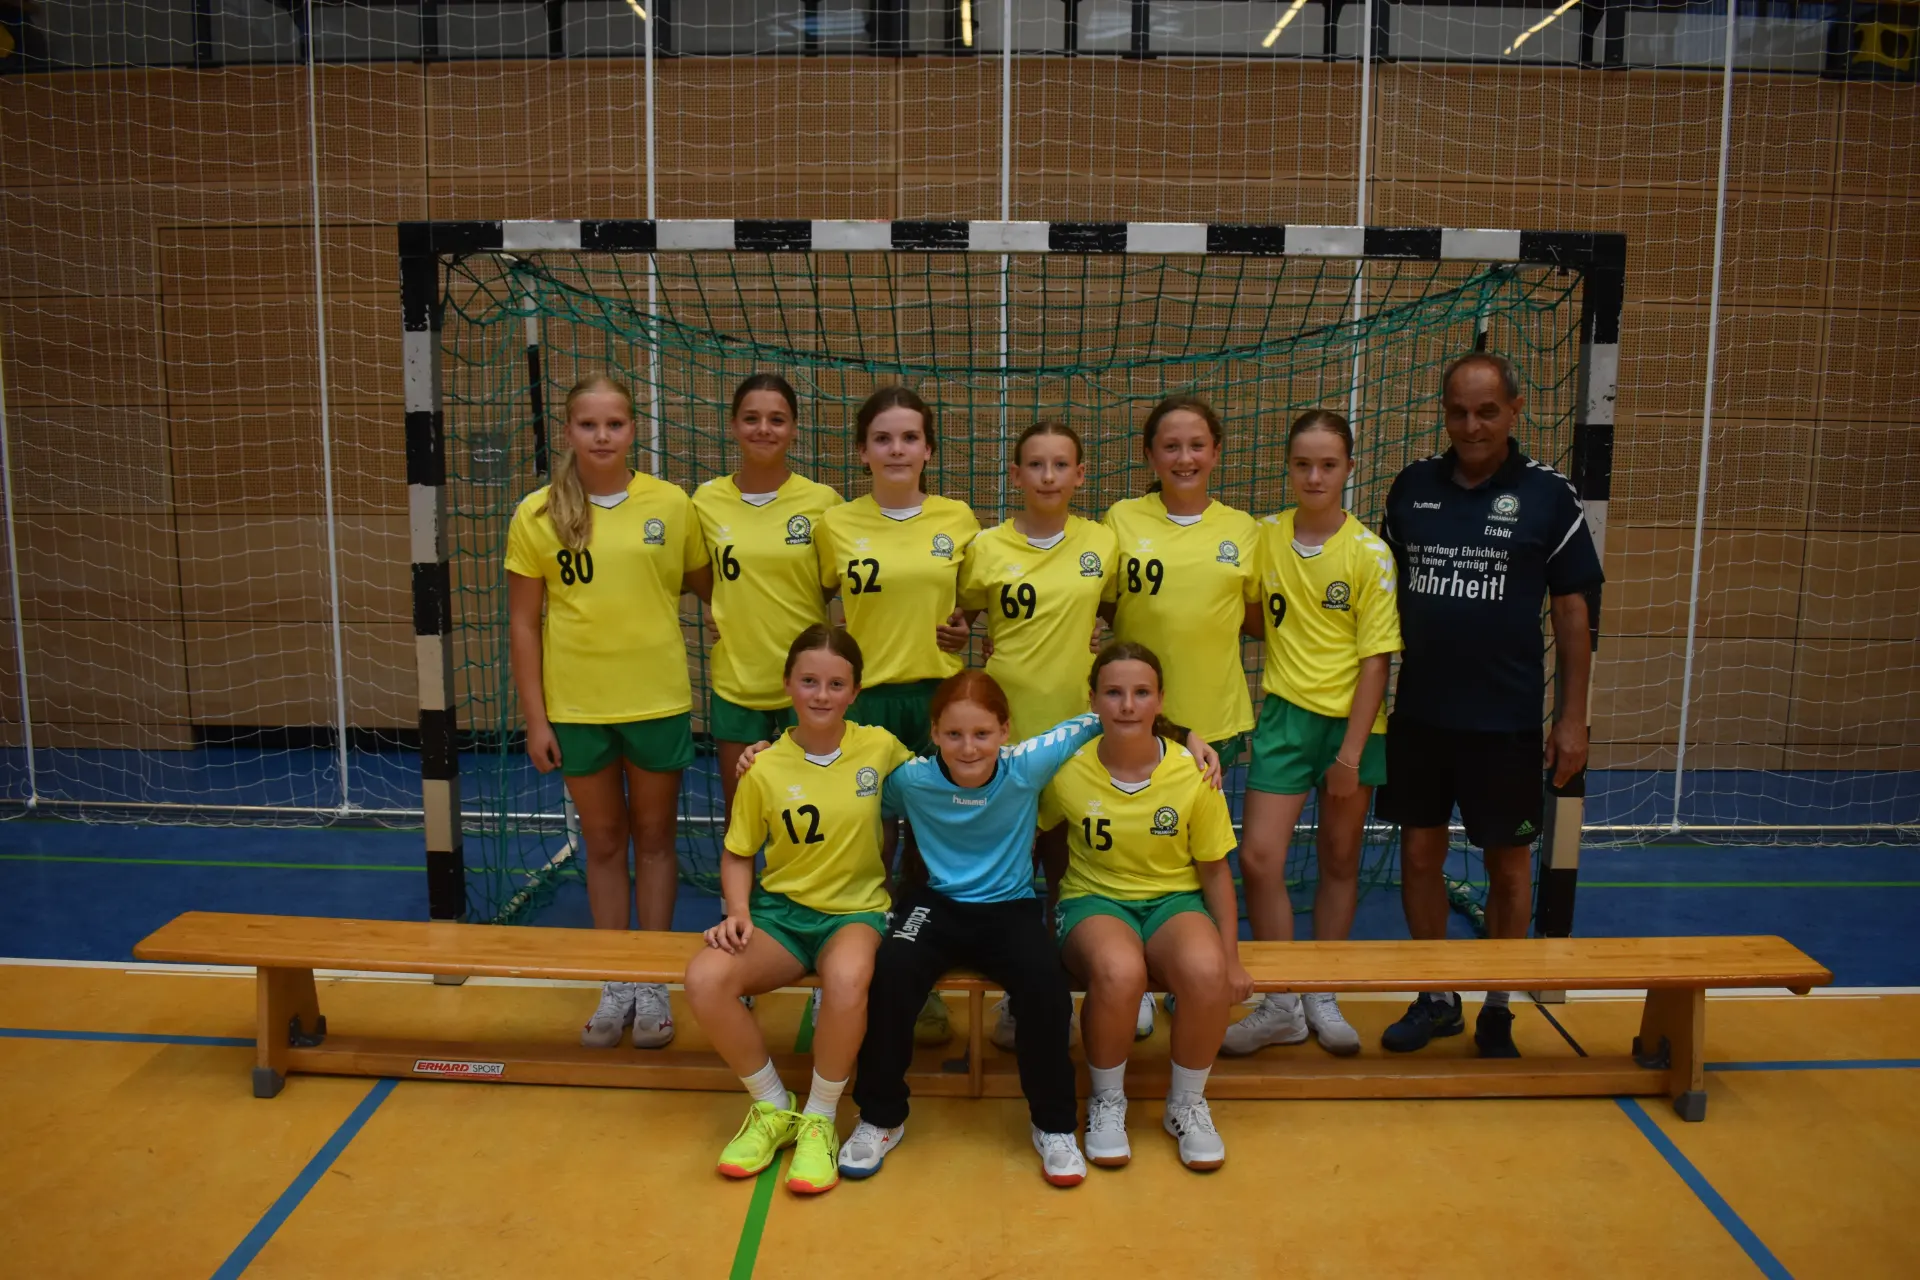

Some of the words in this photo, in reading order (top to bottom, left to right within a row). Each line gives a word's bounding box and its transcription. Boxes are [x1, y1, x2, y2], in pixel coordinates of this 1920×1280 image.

[1413, 500, 1441, 510] hummel
[1484, 525, 1513, 538] Eisbär
[556, 548, 594, 585] 80
[714, 544, 741, 582] 16
[1421, 554, 1447, 567] keiner
[1453, 559, 1489, 572] verträgt
[1494, 560, 1508, 572] die
[1424, 544, 1459, 558] verlangt
[1461, 546, 1510, 561] Ehrlichkeit,
[847, 558, 882, 595] 52
[1127, 557, 1164, 595] 89
[1408, 566, 1506, 601] Wahrheit!
[999, 583, 1037, 619] 69
[1268, 592, 1287, 629] 9
[952, 794, 988, 807] hummel
[781, 804, 825, 845] 12
[1081, 817, 1113, 851] 15
[892, 906, 931, 942] Kempa
[417, 1062, 469, 1072] ERHARD
[472, 1064, 500, 1073] SPORT
